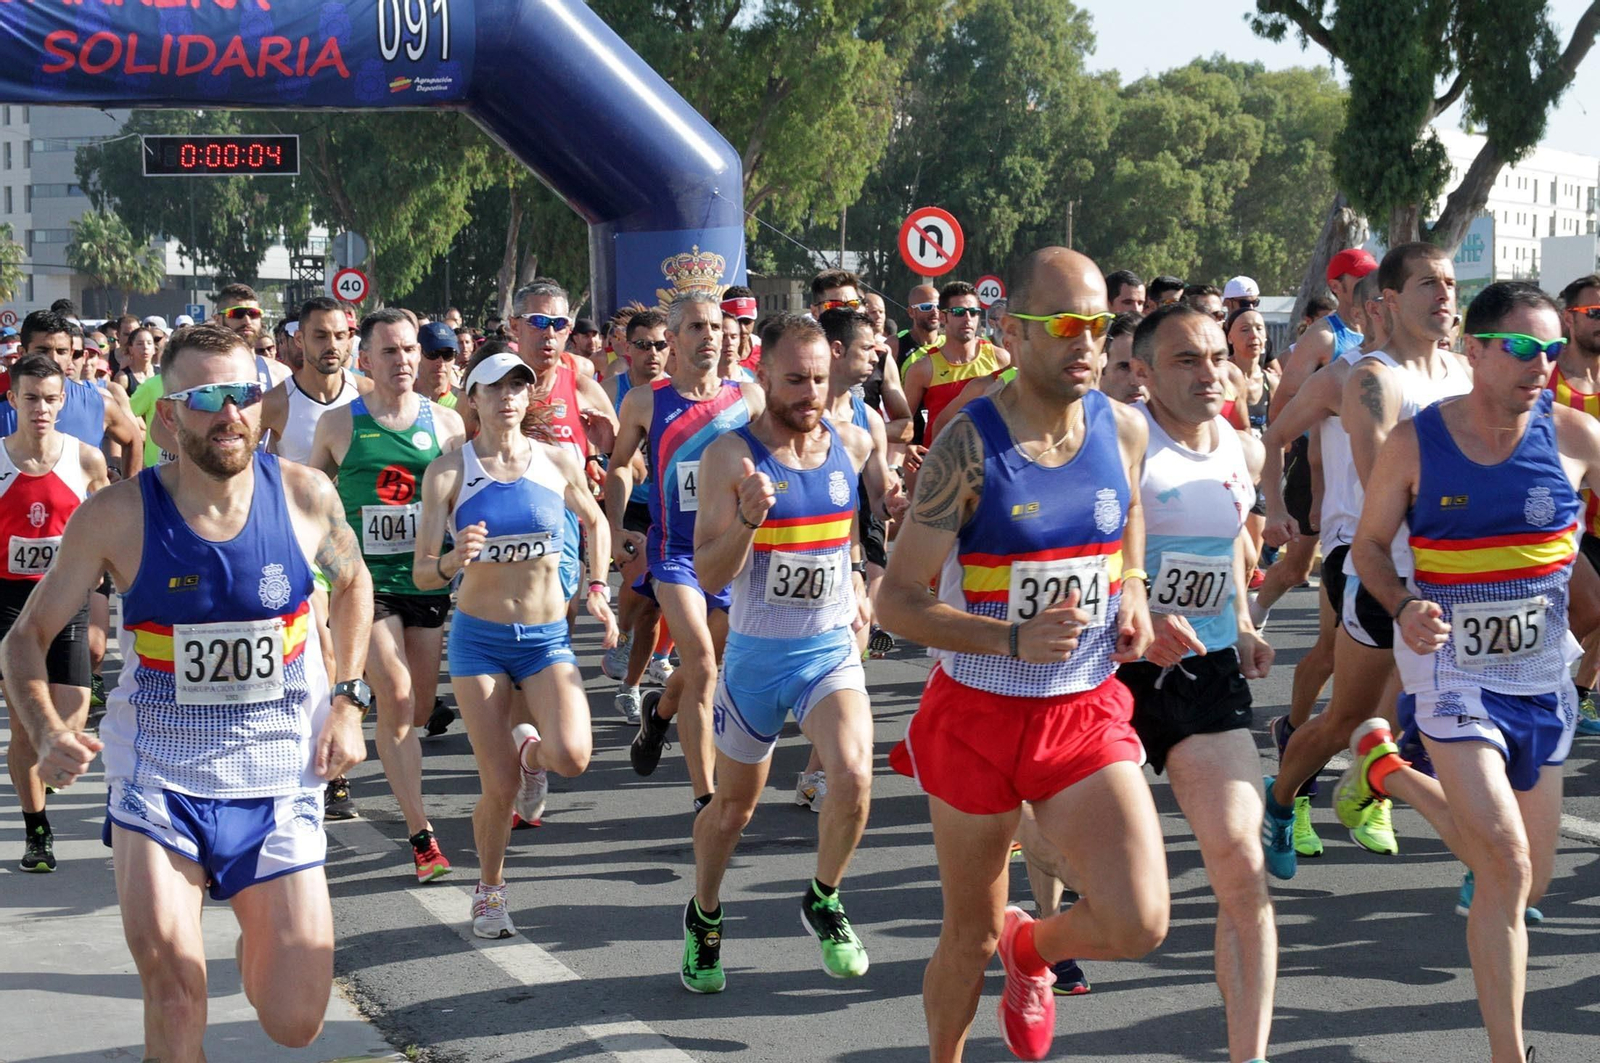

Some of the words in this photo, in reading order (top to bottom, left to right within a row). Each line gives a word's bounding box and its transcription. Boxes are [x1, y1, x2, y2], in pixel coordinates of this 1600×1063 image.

[378, 0, 449, 61] 091
[42, 30, 350, 78] SOLIDARIA
[181, 144, 282, 168] 0:00:04
[339, 278, 361, 292] 40
[980, 286, 999, 298] 40
[190, 305, 201, 319] P
[161, 450, 179, 462] 40
[368, 513, 417, 541] 4041
[14, 545, 60, 569] 429
[773, 563, 836, 600] 3201
[1018, 572, 1101, 620] 3204
[1158, 568, 1227, 609] 3301
[1463, 609, 1538, 657] 3205
[184, 636, 275, 683] 3203
